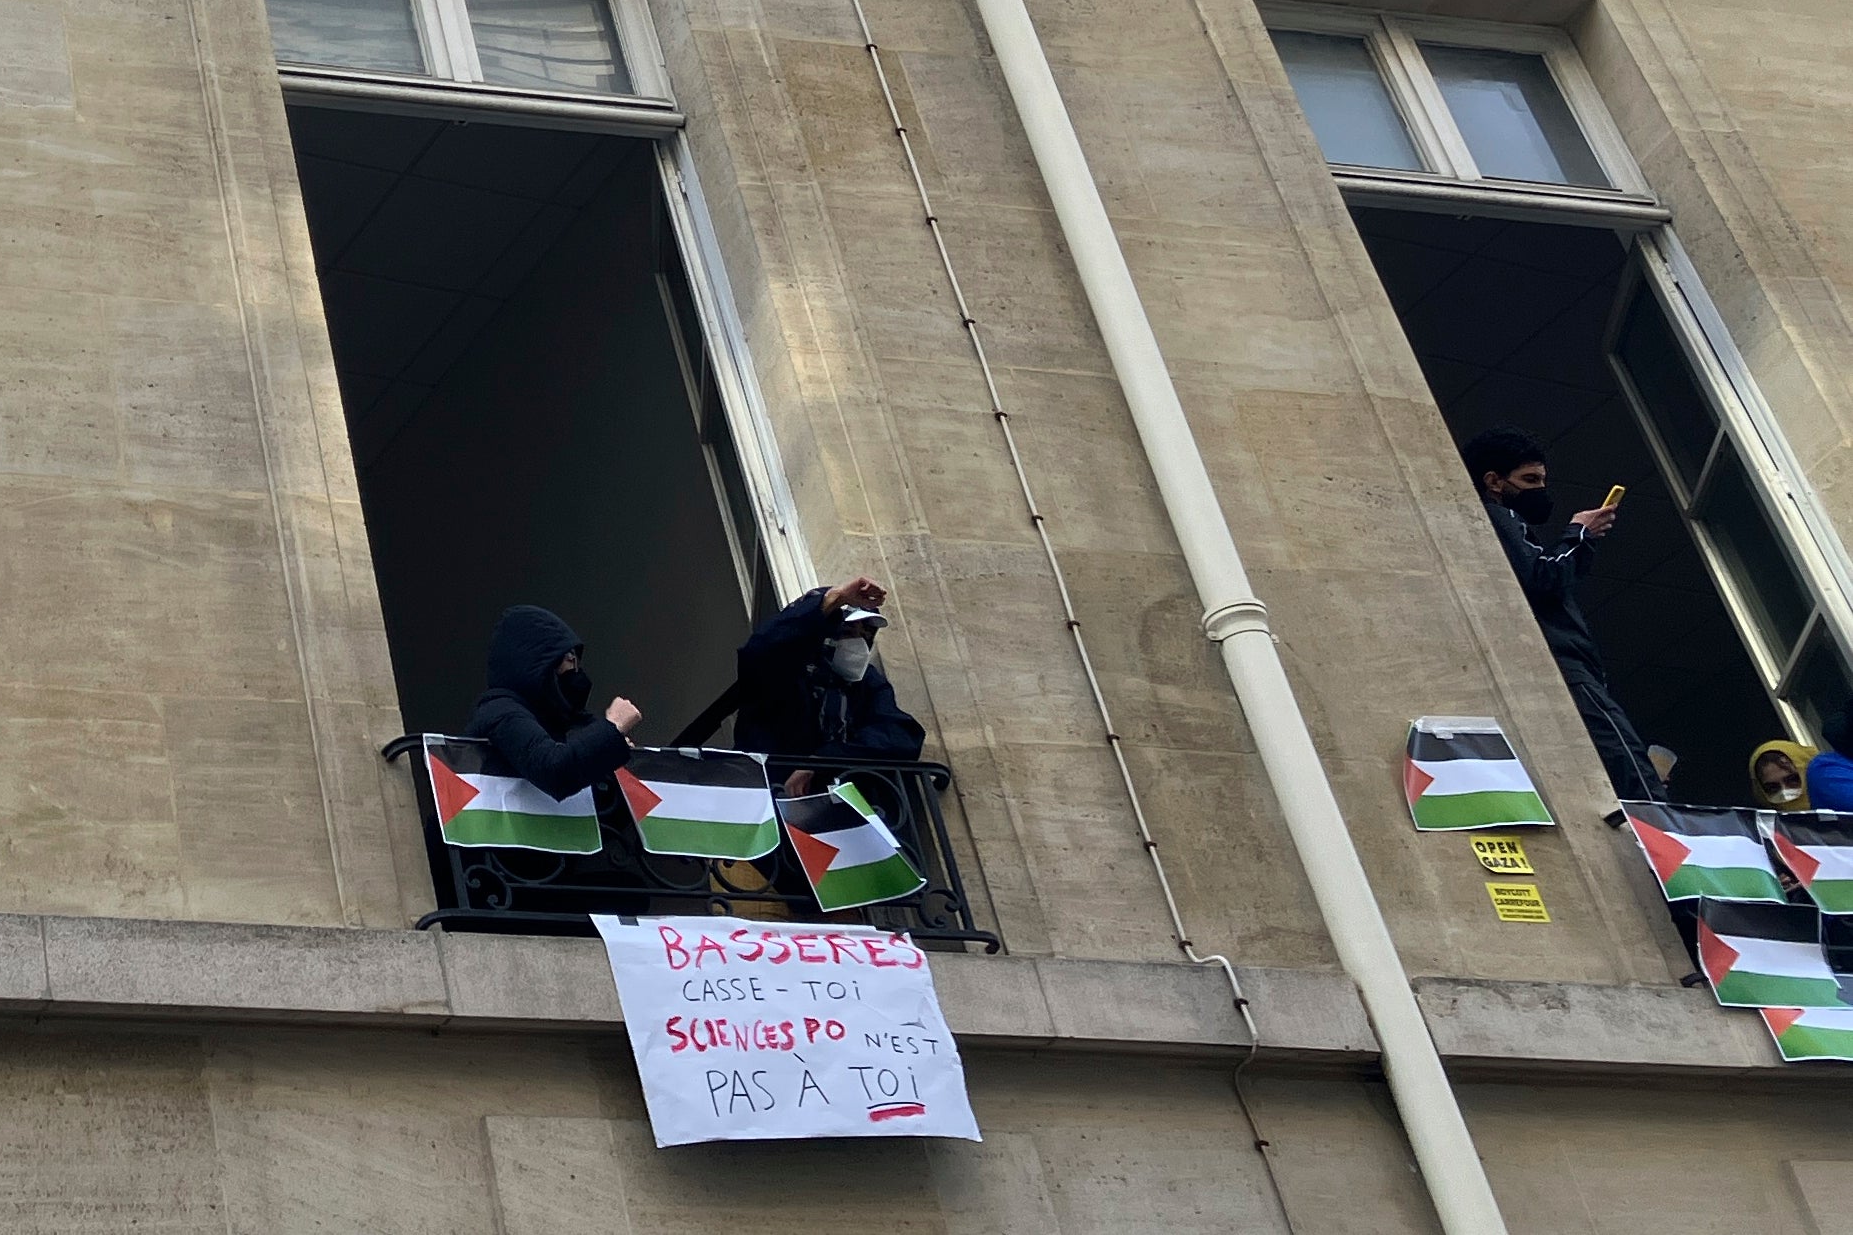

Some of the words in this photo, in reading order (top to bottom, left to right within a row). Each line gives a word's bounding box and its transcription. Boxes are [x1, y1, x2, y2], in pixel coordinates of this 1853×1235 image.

[1474, 841, 1519, 854] OPEN
[658, 925, 924, 970] BASSERES
[665, 1015, 796, 1054] SCIENCES
[804, 1017, 846, 1045] PO
[864, 1032, 941, 1055] N'EST
[704, 1068, 776, 1118] PAS
[793, 1051, 830, 1108] À
